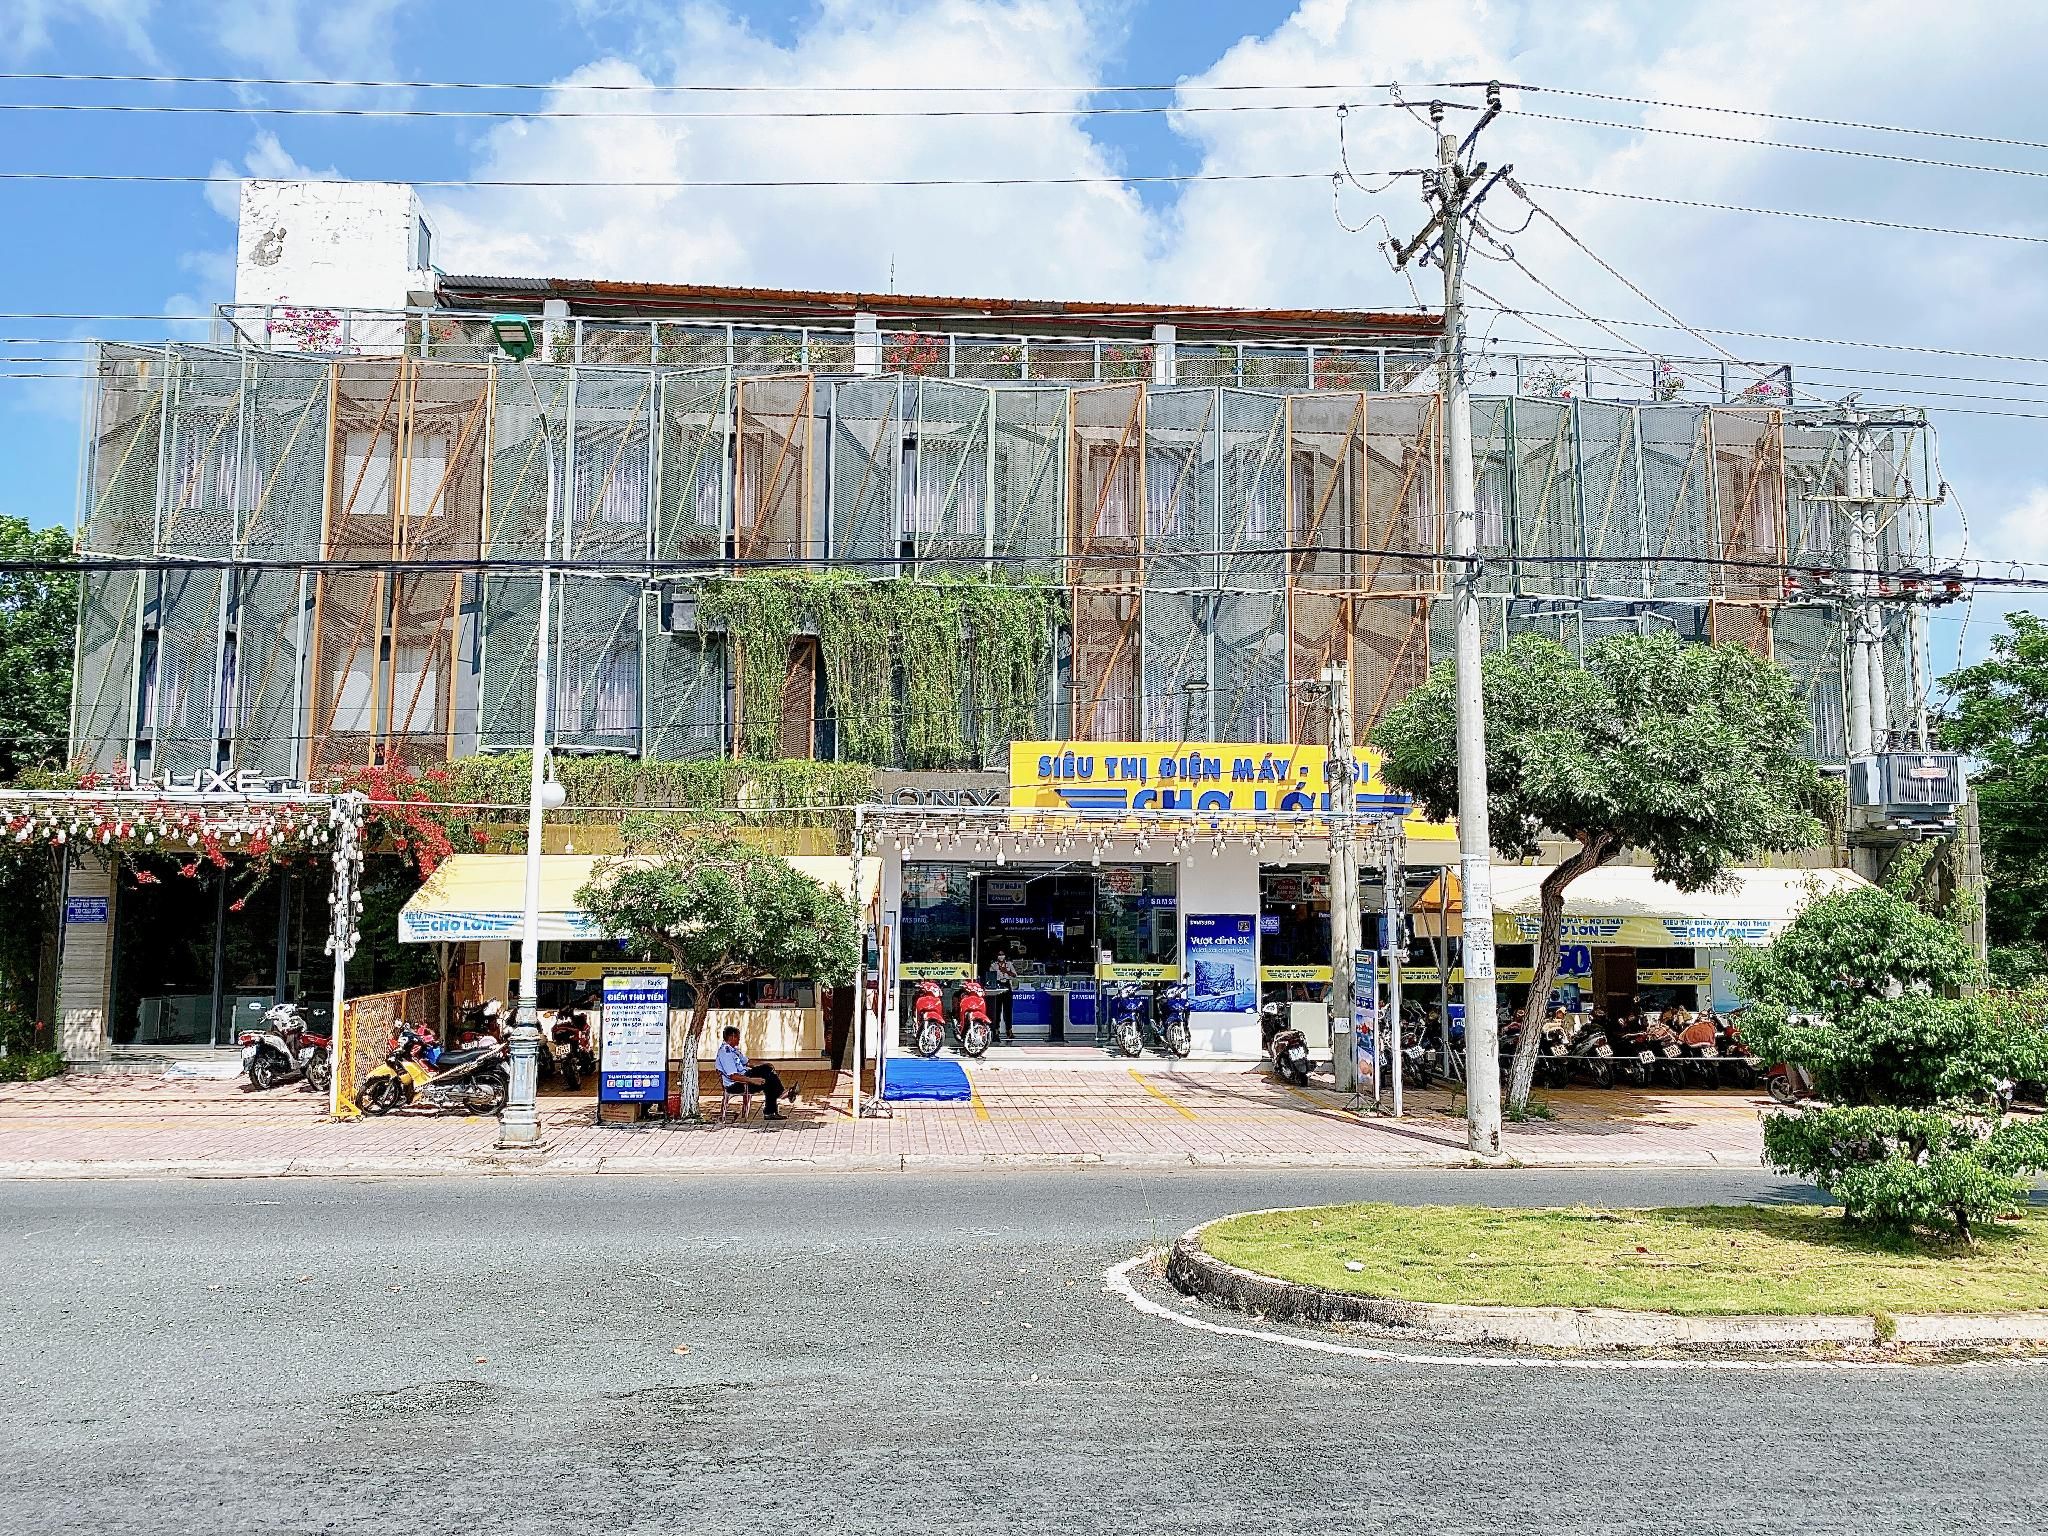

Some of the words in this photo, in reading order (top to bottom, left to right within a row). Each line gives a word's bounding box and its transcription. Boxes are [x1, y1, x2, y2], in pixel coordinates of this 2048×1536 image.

[130, 766, 271, 793] LUXE
[1038, 751, 1094, 779] SIÊU
[1104, 757, 1147, 787] THỊ
[1158, 752, 1221, 787] ĐIỆN
[1232, 752, 1291, 783] MÁY
[1132, 789, 1234, 825] CHỢ
[1190, 936, 1213, 947] Vượt
[1238, 936, 1250, 945] 8K
[629, 993, 646, 1001] THU
